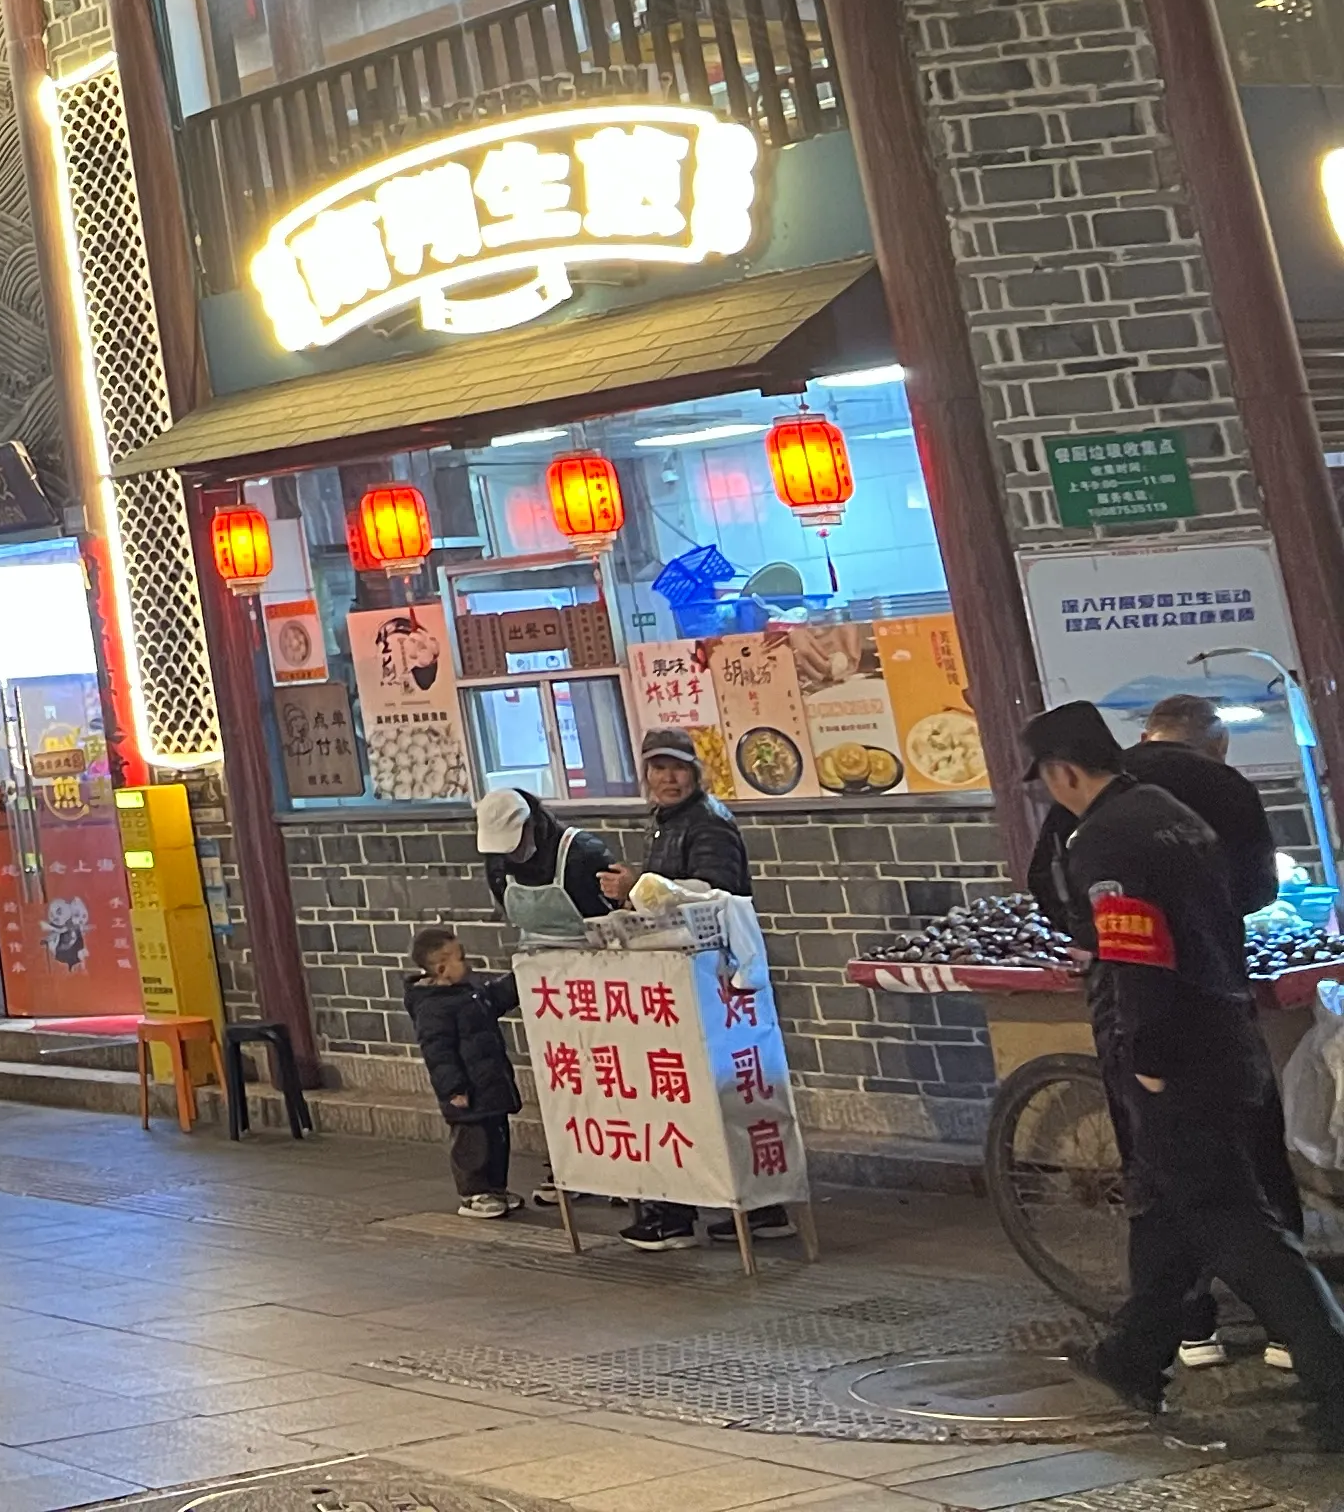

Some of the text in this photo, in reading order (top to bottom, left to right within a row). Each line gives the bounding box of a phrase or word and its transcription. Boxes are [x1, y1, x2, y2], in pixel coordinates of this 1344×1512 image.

[1062, 588, 1251, 614] 深入开展爱国卫生运动
[1066, 607, 1255, 632] 提高人民群众健康素质
[645, 675, 704, 705] 炸洋芋
[313, 710, 347, 730] 点单
[316, 739, 352, 757] 付款
[531, 976, 680, 1027] 大理风味
[543, 1041, 691, 1104] 烤乳扇
[565, 1116, 695, 1168] 10元/个
